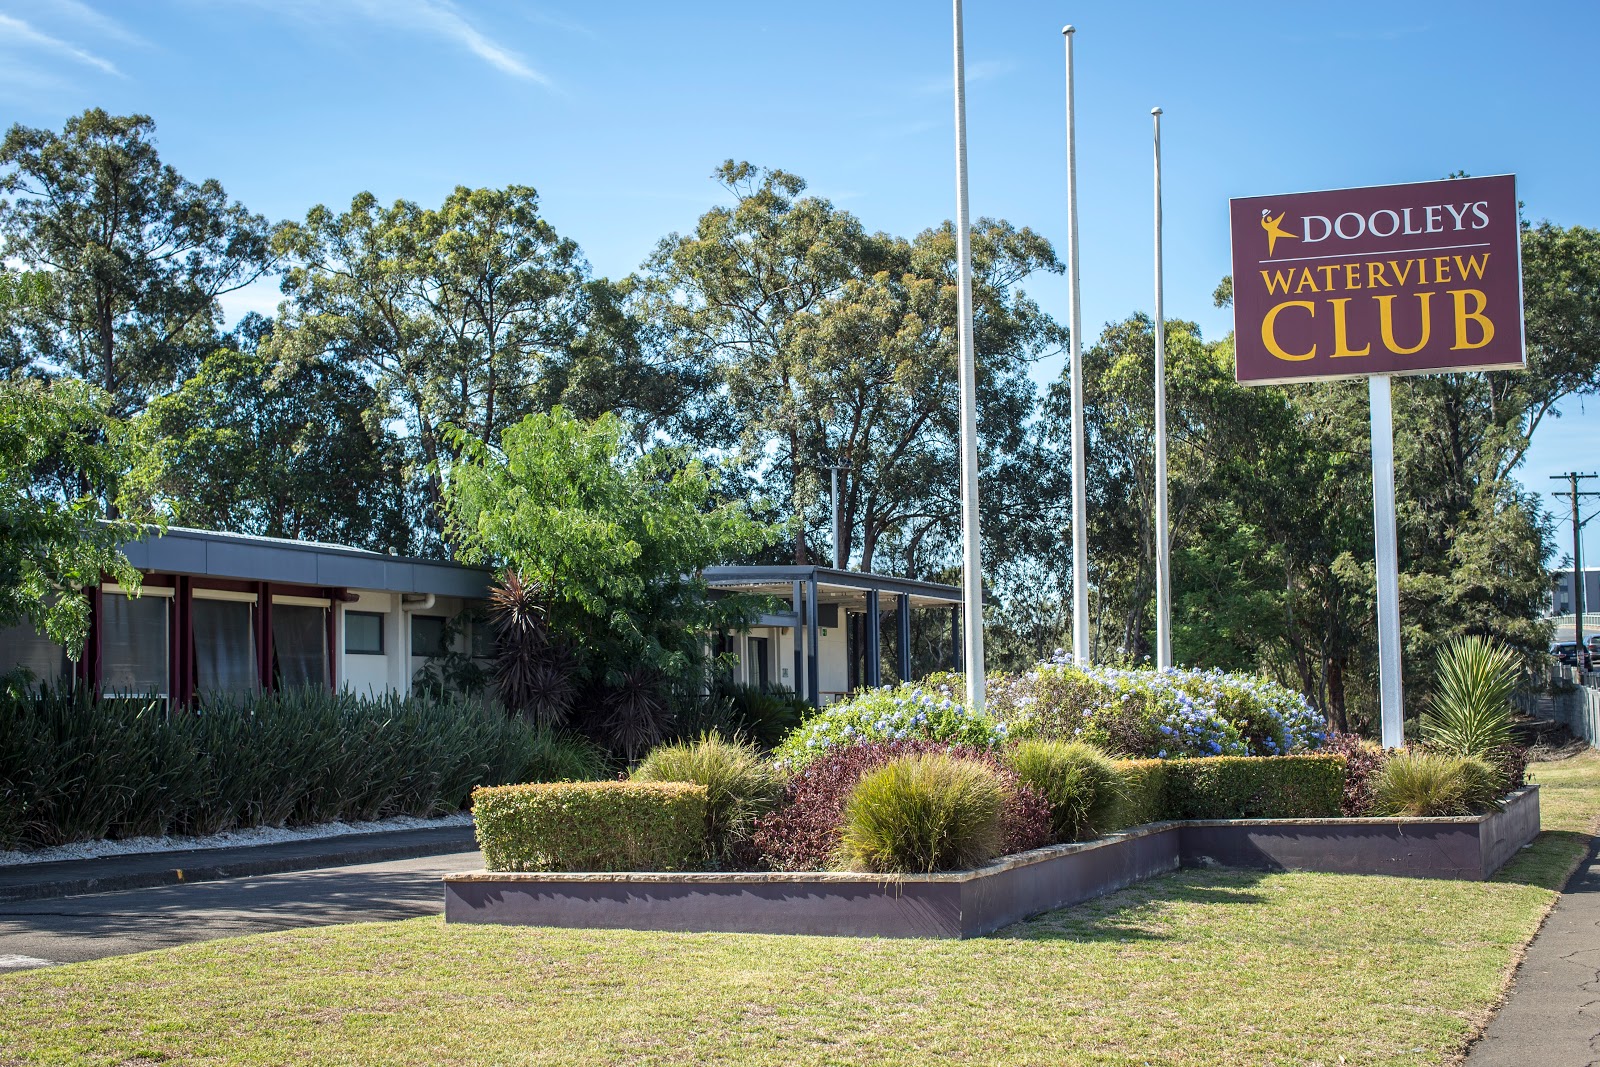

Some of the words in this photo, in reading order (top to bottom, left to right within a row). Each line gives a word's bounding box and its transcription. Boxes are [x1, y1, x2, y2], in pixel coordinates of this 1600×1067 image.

[1300, 201, 1490, 243] DOOLEYS
[1260, 253, 1491, 296] WATERVIEW
[1261, 288, 1495, 362] CLUB
